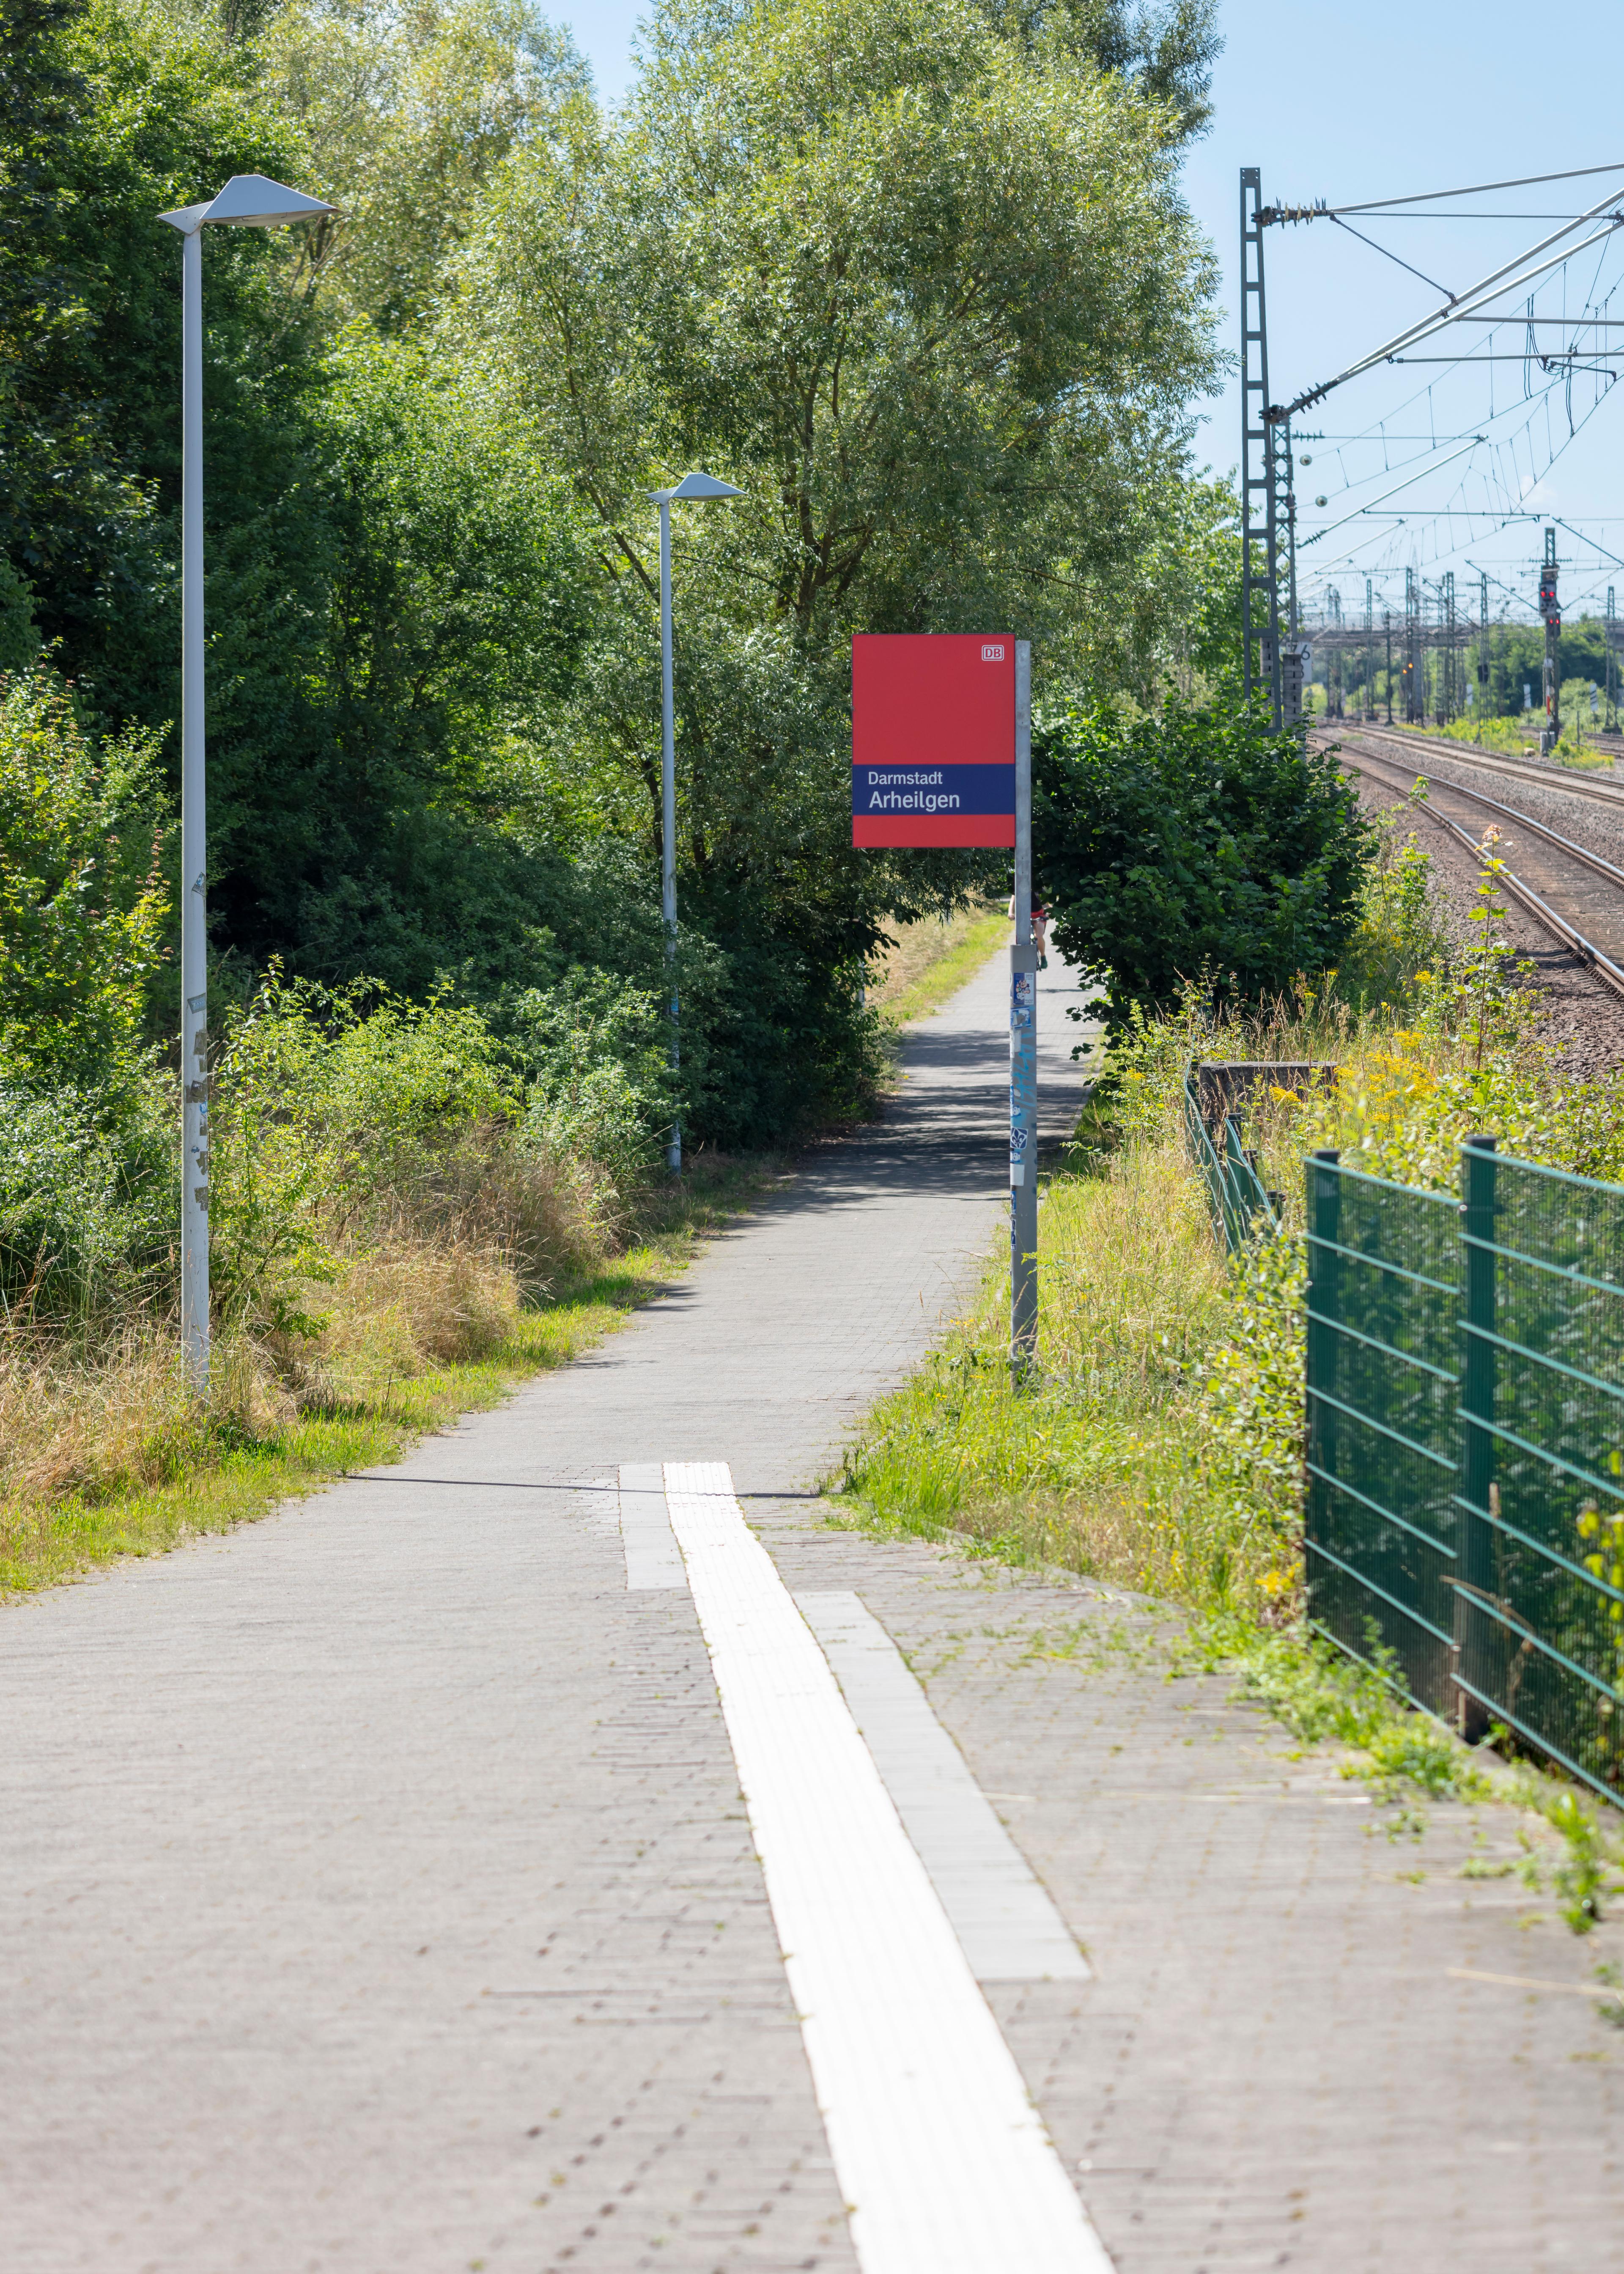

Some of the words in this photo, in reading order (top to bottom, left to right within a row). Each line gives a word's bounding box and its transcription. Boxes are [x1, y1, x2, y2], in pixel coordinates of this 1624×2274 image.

[985, 648, 1001, 657] DB
[868, 771, 943, 785] Darmstadt
[869, 791, 960, 812] Arheilgen
